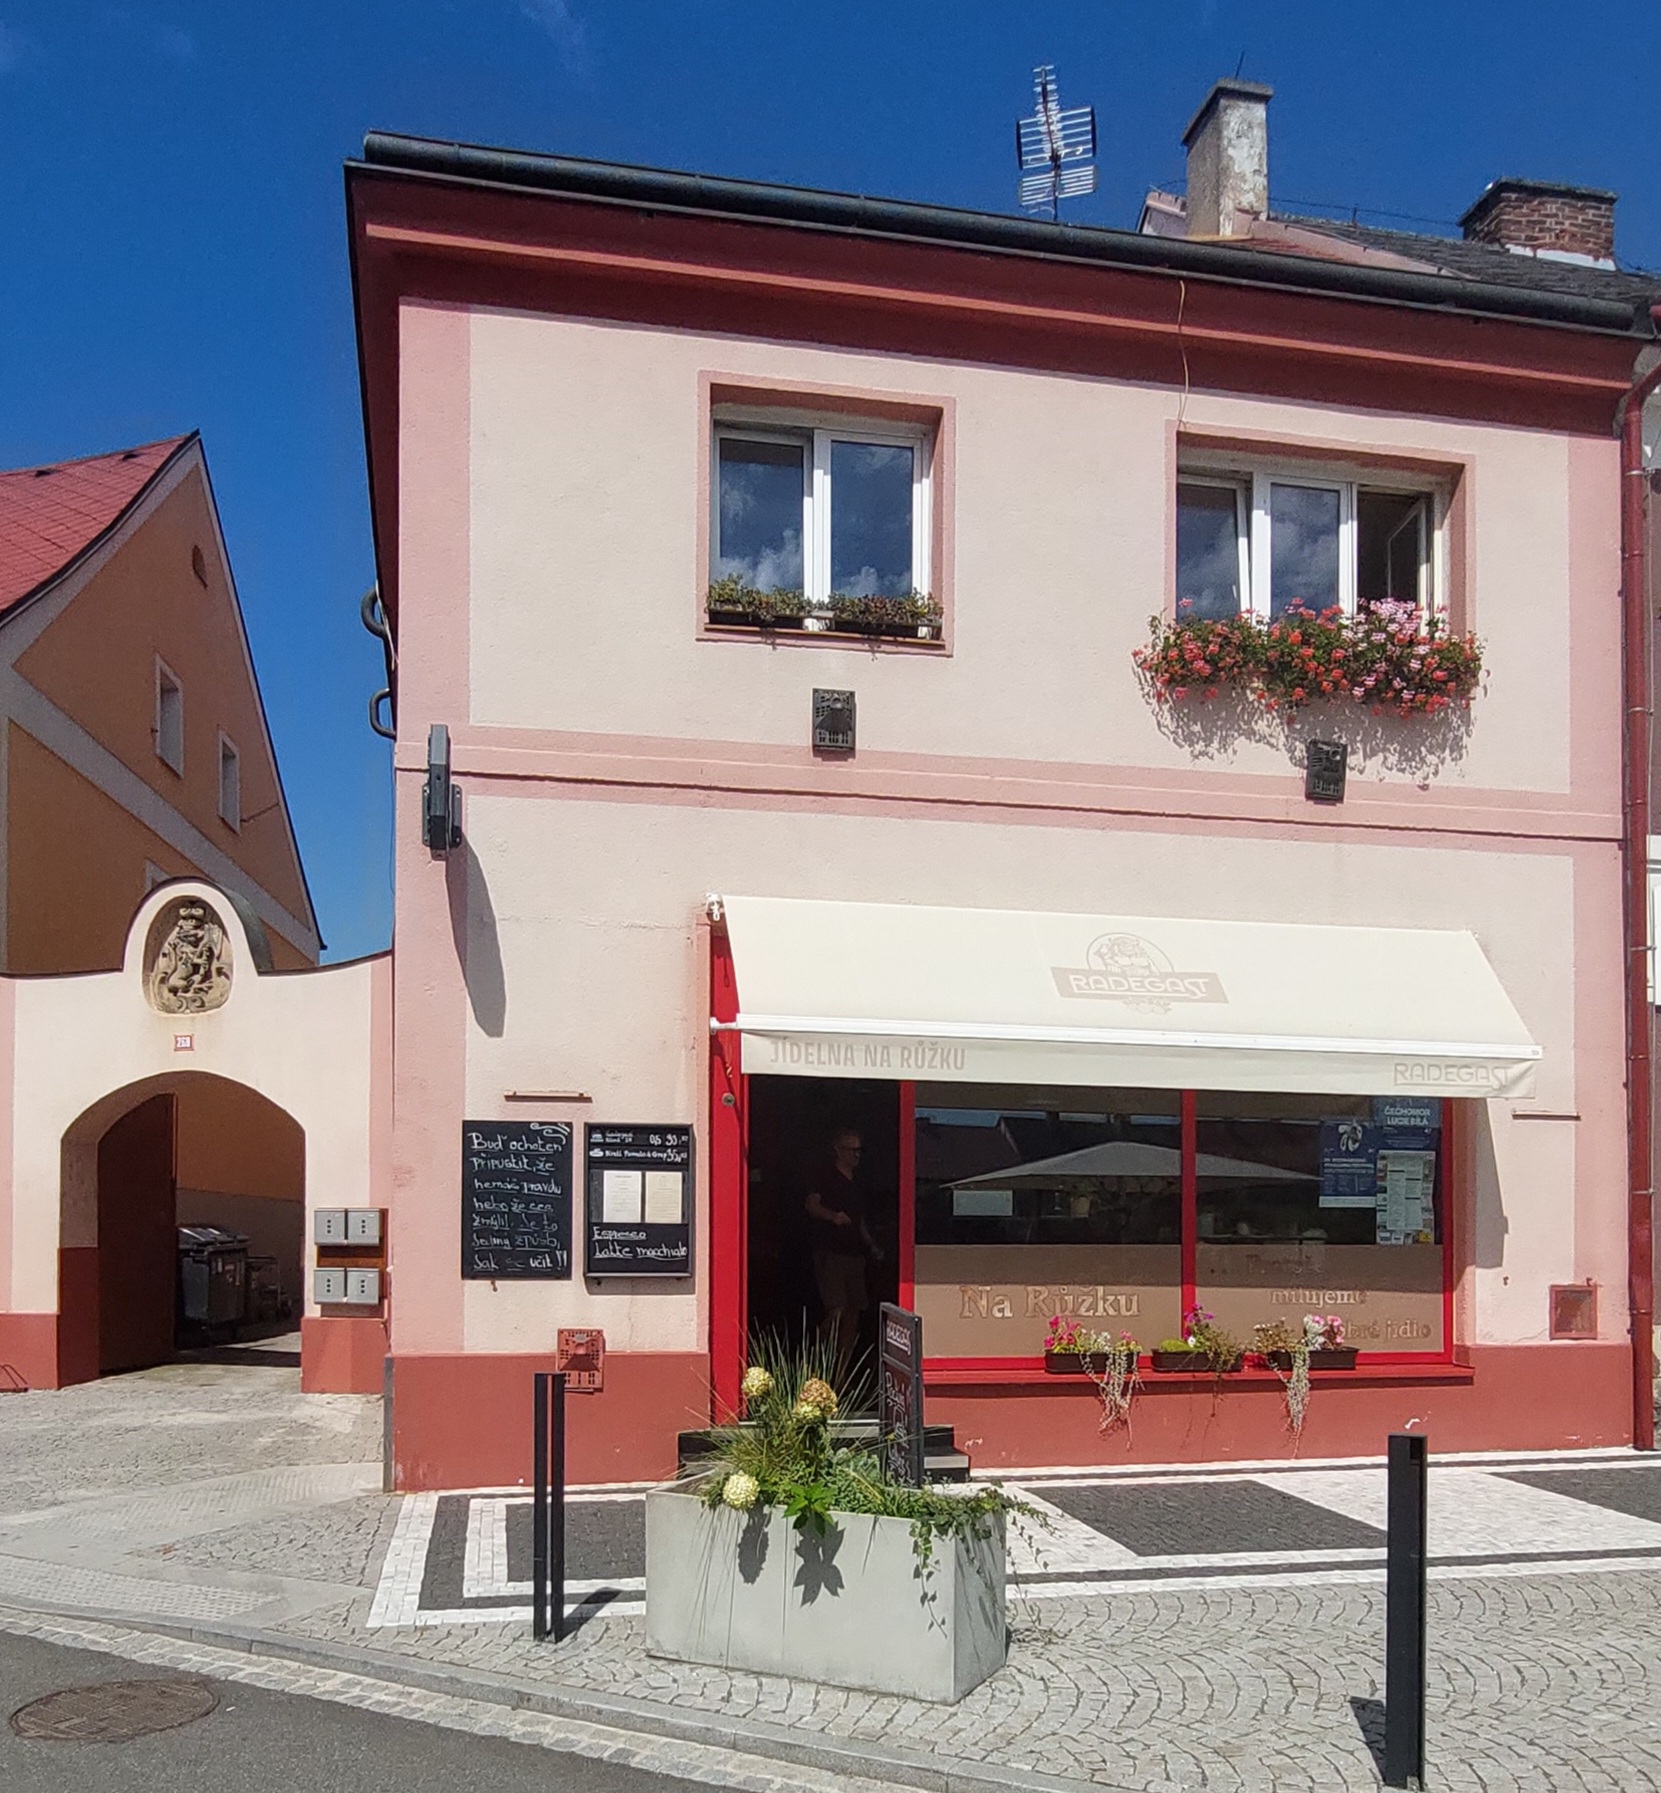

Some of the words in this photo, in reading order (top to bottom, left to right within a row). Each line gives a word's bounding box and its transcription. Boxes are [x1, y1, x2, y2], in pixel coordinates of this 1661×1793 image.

[1068, 974, 1210, 999] RADEGAST
[770, 1039, 856, 1066] JÍDELNA
[863, 1044, 892, 1068] NA
[900, 1040, 966, 1071] RŮŽKU
[1394, 1062, 1511, 1091] RADEGAST
[467, 1132, 507, 1150] Buď
[510, 1134, 562, 1151] ochoten
[537, 1156, 556, 1172] že
[594, 1241, 633, 1257] Latte
[529, 1253, 553, 1268] učit
[958, 1285, 1013, 1318] Na
[1025, 1285, 1141, 1319] Růžku
[1269, 1287, 1368, 1308] milujeme
